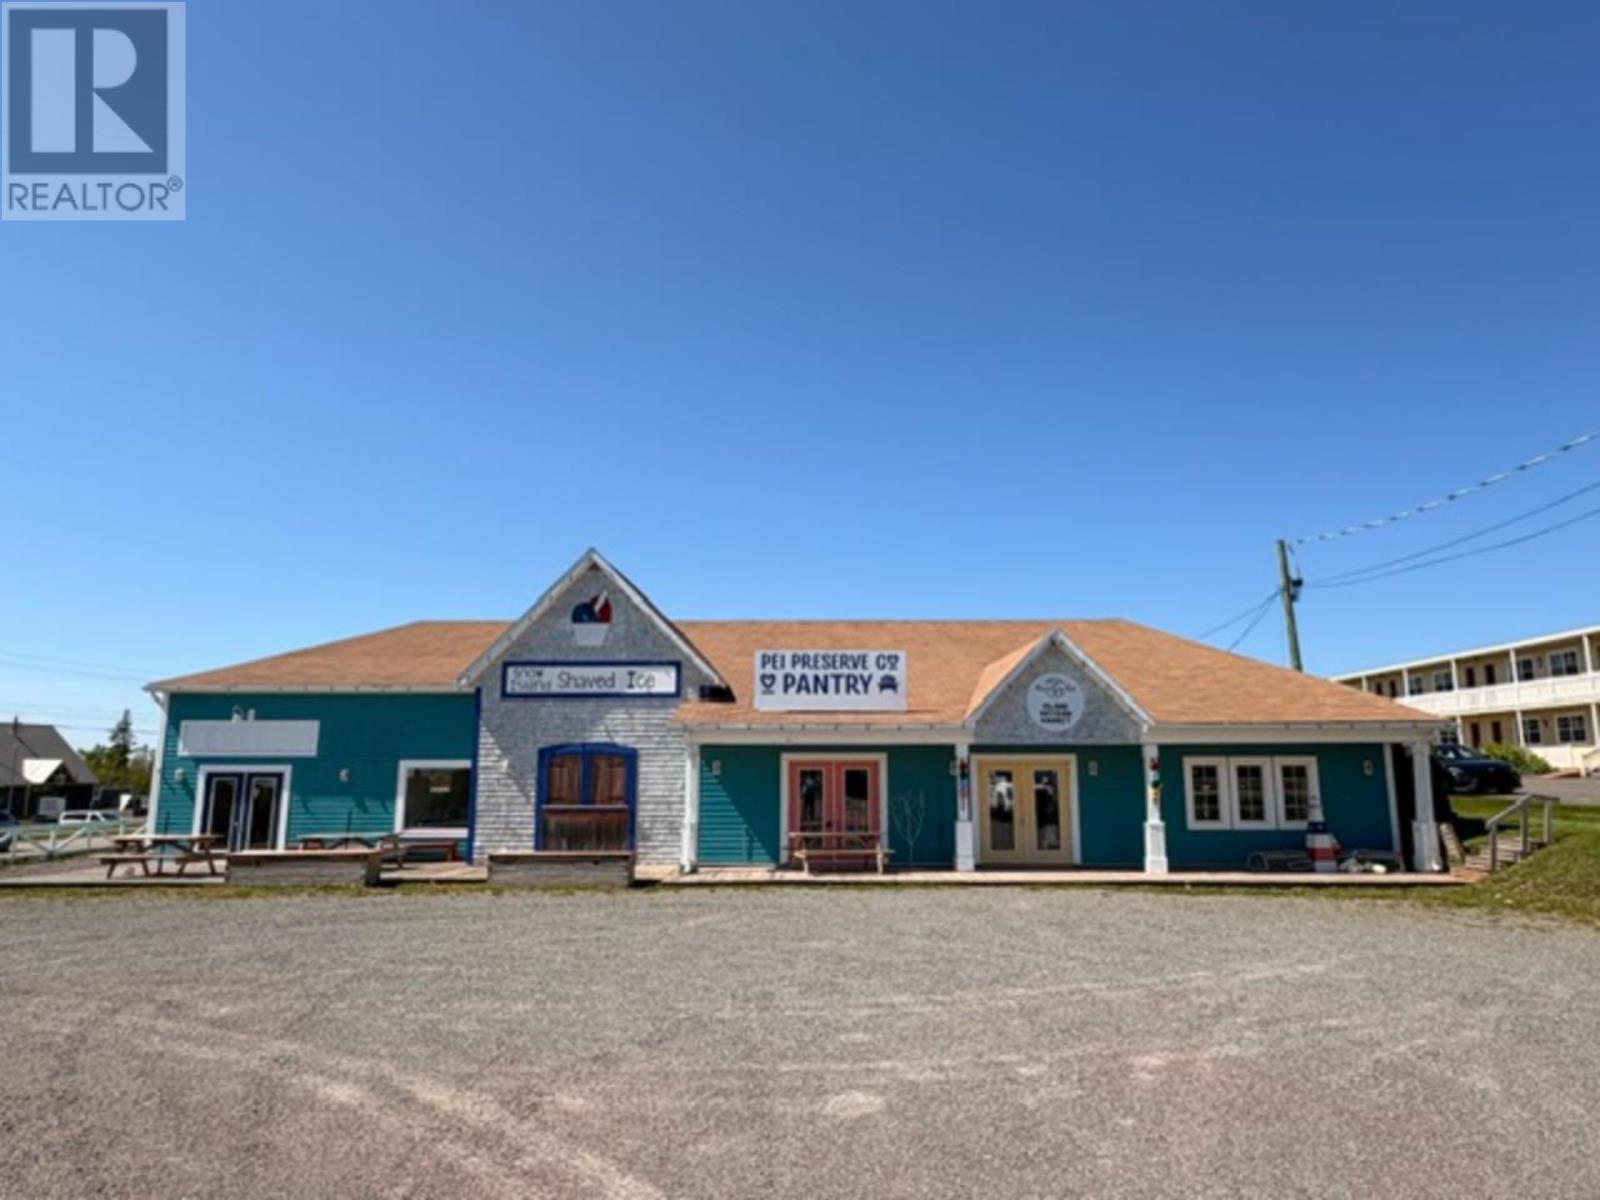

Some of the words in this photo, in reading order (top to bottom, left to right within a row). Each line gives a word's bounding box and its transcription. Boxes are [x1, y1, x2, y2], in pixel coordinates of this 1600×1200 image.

[761, 653, 786, 670] PEI
[791, 653, 869, 670] PRESERVE
[557, 670, 616, 689] Shaved
[626, 670, 656, 689] Ice
[782, 673, 873, 695] PANTRY
